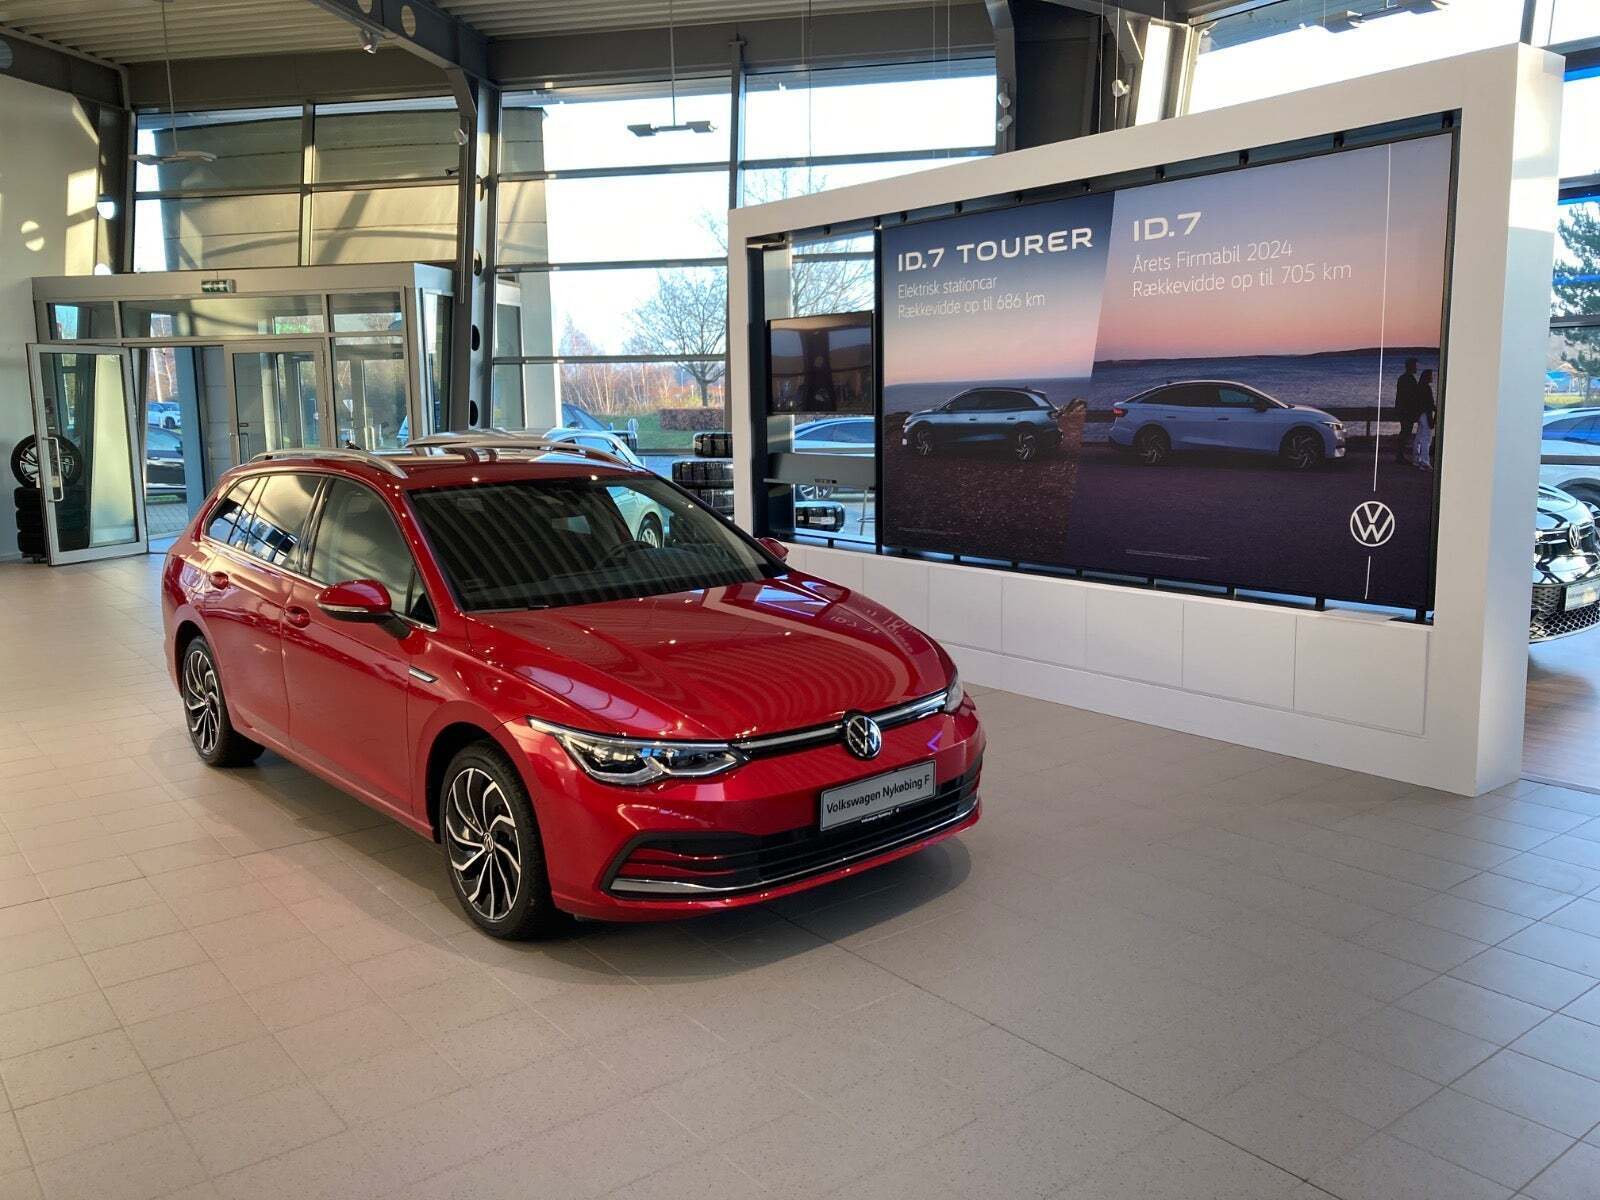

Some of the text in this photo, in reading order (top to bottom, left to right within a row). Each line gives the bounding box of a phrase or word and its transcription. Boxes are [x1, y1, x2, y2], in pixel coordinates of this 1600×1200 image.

[1133, 211, 1202, 242] ID.7
[898, 227, 1094, 272] ID.7 TOURER
[1132, 239, 1293, 273] Årets Firmabil 2024
[898, 276, 998, 299] Elektrisk stationcar
[1133, 262, 1352, 298] Rækkevidde op til 705 km
[898, 291, 1045, 320] Rækkevidde op til 686 km
[826, 774, 931, 814] Volkswagen Nykøbing F
